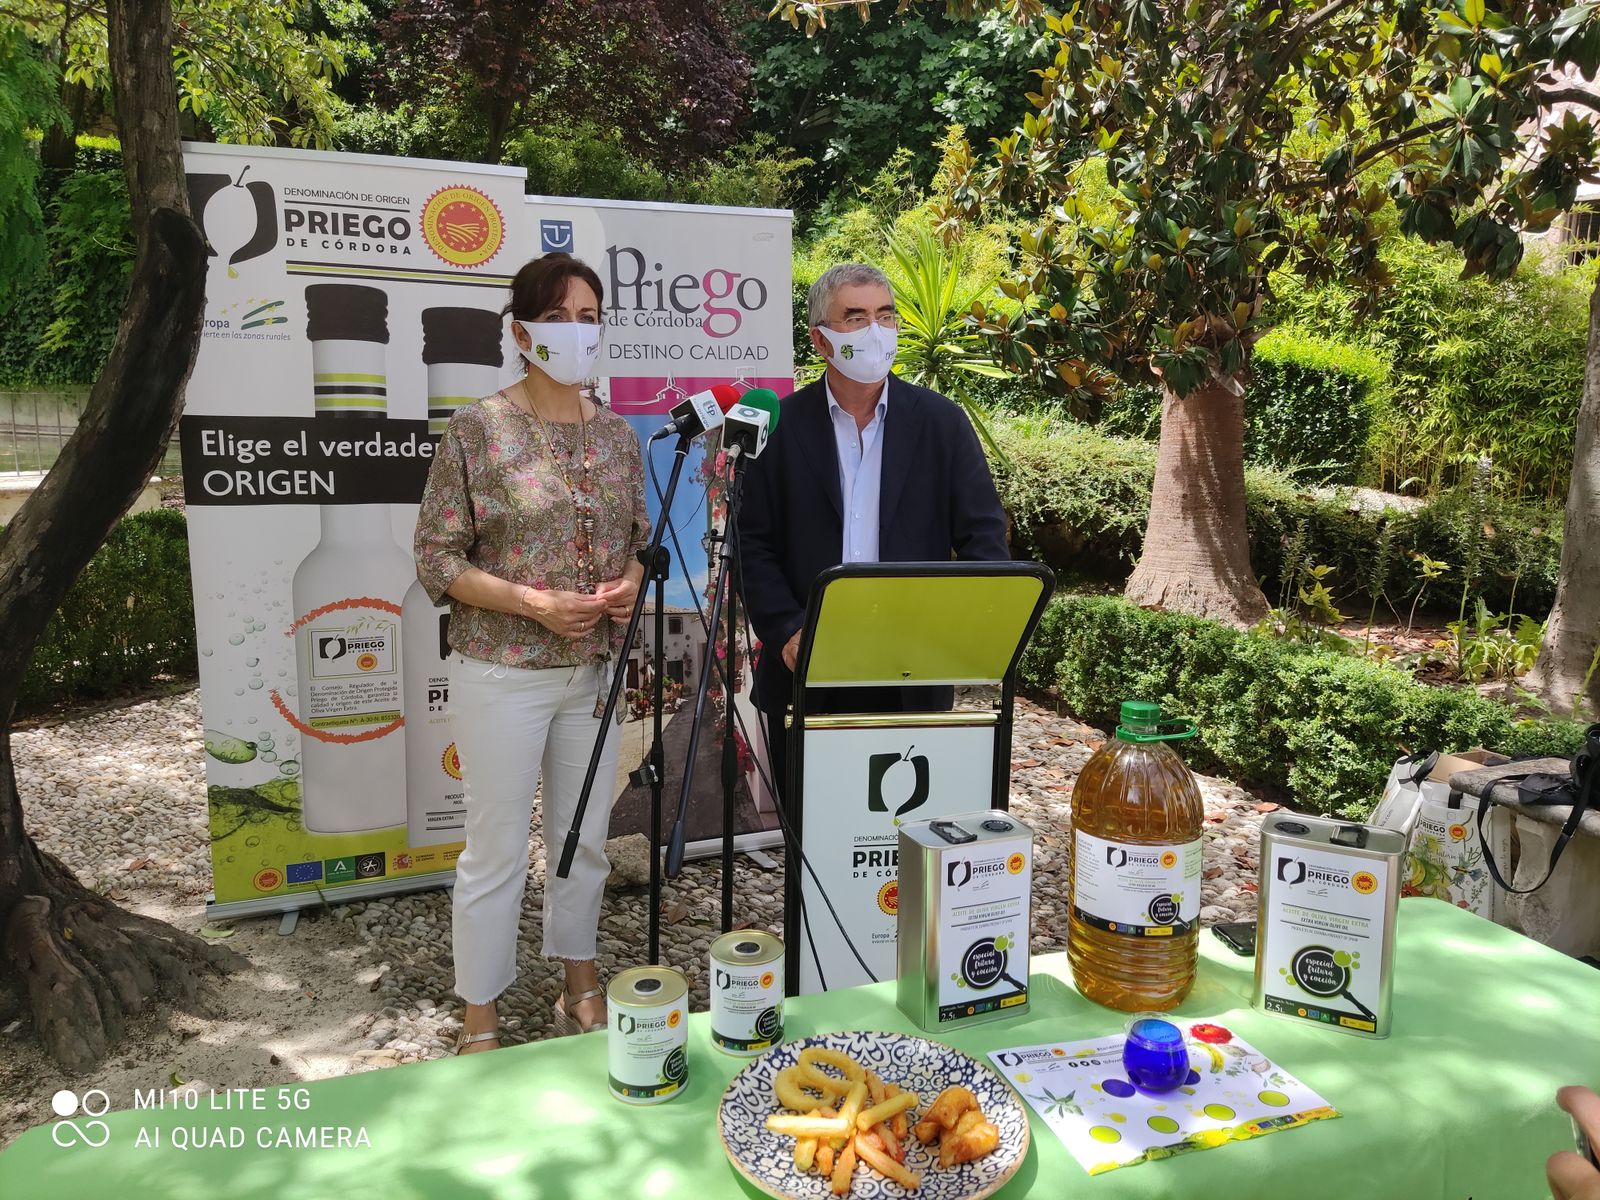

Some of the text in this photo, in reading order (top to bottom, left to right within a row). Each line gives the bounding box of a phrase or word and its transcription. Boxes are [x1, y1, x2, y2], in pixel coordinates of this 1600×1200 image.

[284, 187, 410, 205] DENOMINACIÓN DE ORIGEN
[284, 209, 411, 241] PRIEGO
[286, 238, 411, 255] DE CÓRDOBA
[606, 244, 767, 339] Priego
[608, 309, 704, 328] de Córdoba
[609, 343, 684, 360] DESTINO
[690, 344, 769, 361] CALIDAD
[201, 429, 271, 464] Elige
[283, 430, 307, 457] el
[203, 469, 335, 497] ORIGEN
[348, 641, 385, 650] PRIEGO
[1128, 856, 1159, 864] PRIEGO
[972, 863, 1005, 874] PRIEGO
[1308, 870, 1349, 884] PRIEGO
[871, 932, 890, 940] Europa
[973, 949, 995, 960] especial
[1305, 957, 1334, 969] especial
[971, 970, 976, 979] y
[1307, 965, 1334, 977] fritura
[1303, 973, 1338, 986] y cocción
[636, 1020, 666, 1029] PRIEGO
